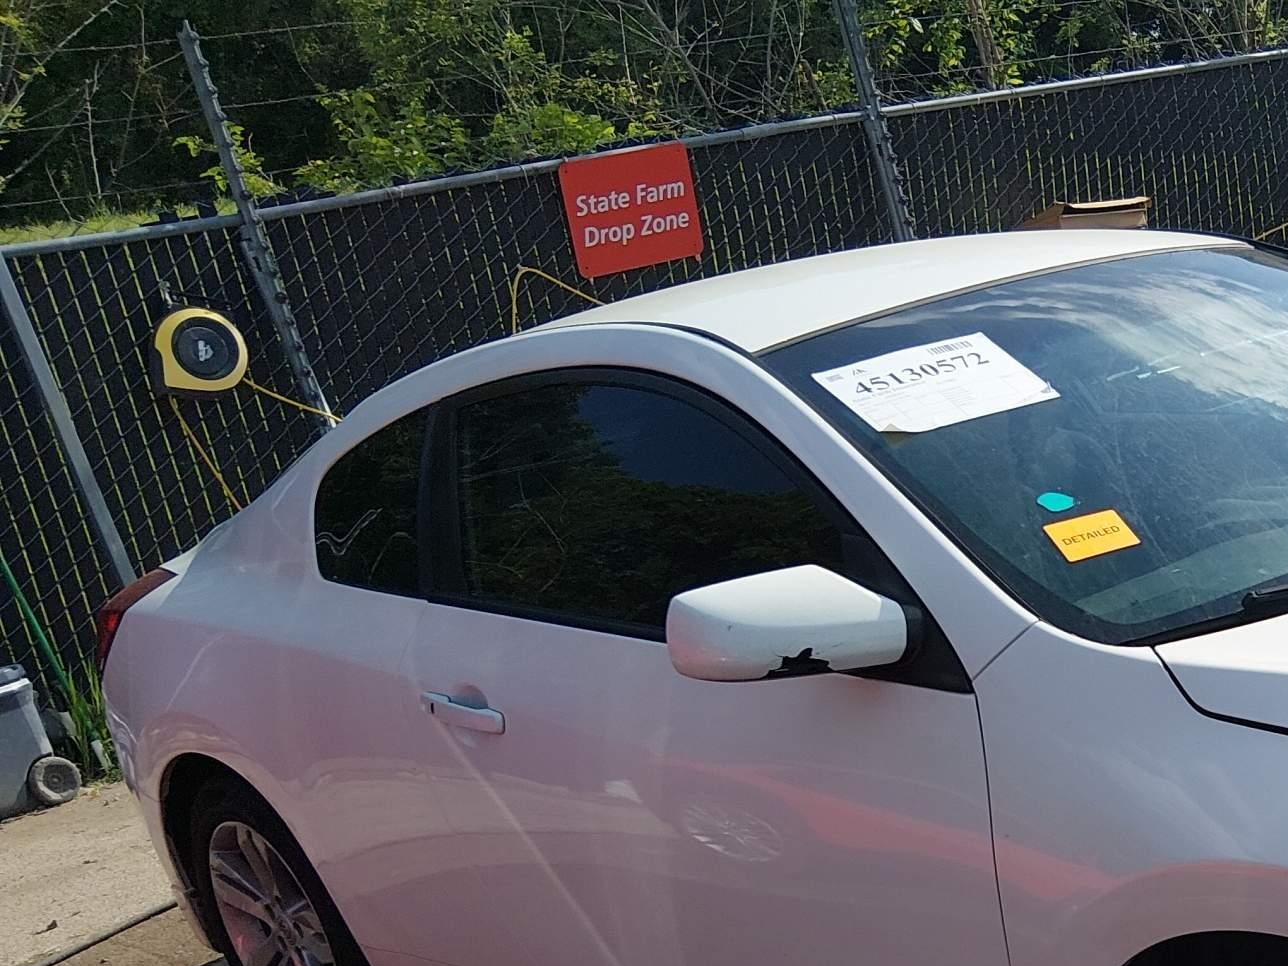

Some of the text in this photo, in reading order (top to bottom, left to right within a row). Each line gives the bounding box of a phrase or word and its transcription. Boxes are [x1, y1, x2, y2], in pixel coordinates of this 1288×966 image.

[576, 181, 685, 217] State Farm
[584, 211, 689, 247] Drop Zone
[855, 352, 990, 395] 45130572
[1061, 525, 1121, 546] DETAILED
